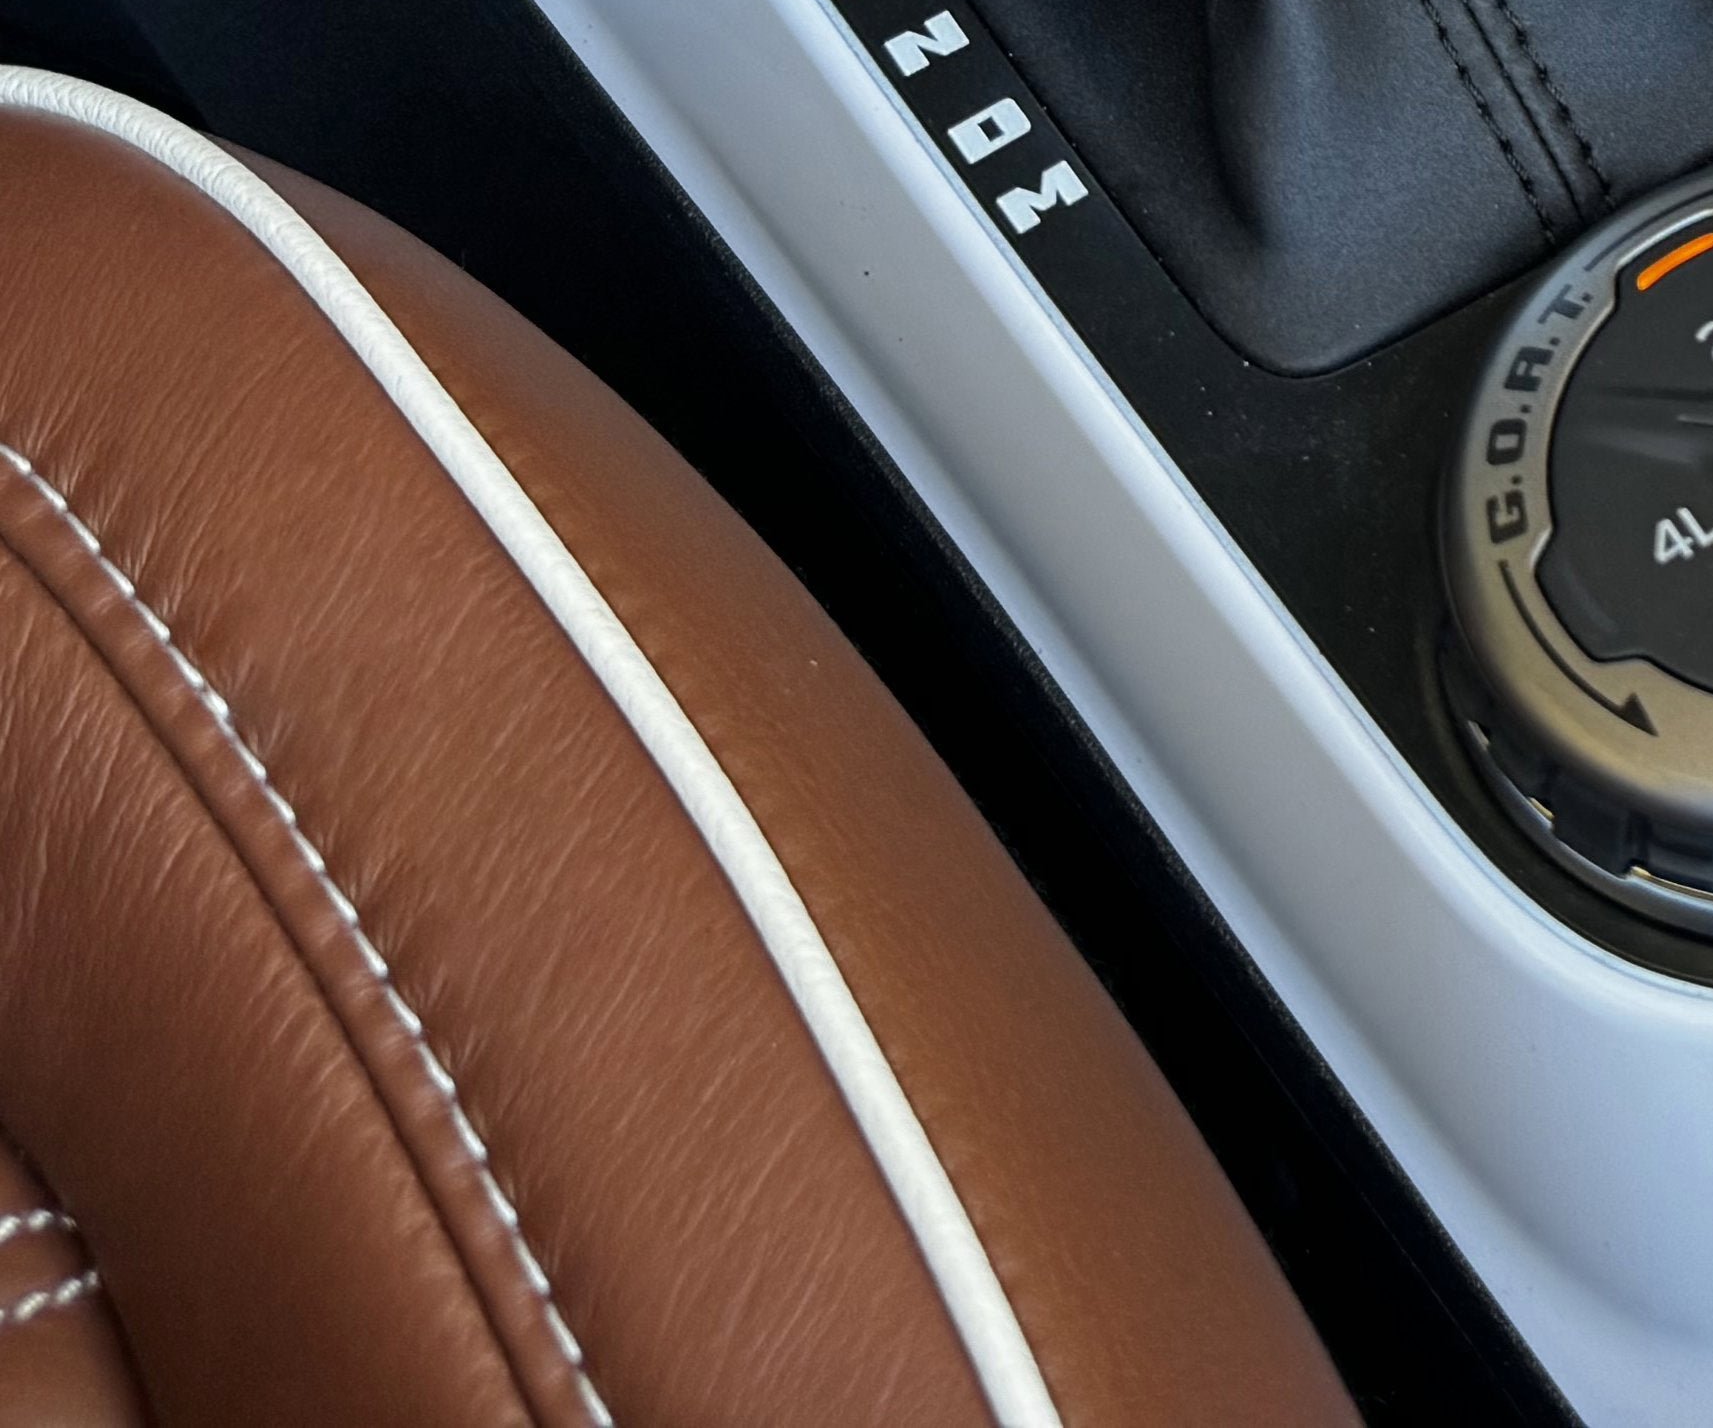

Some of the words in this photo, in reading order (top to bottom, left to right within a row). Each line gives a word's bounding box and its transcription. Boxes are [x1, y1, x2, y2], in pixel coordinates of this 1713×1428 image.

[885, 10, 970, 76] N
[948, 97, 1032, 165] D
[996, 160, 1089, 234] M
[1486, 283, 1596, 545] G.O.A.T.
